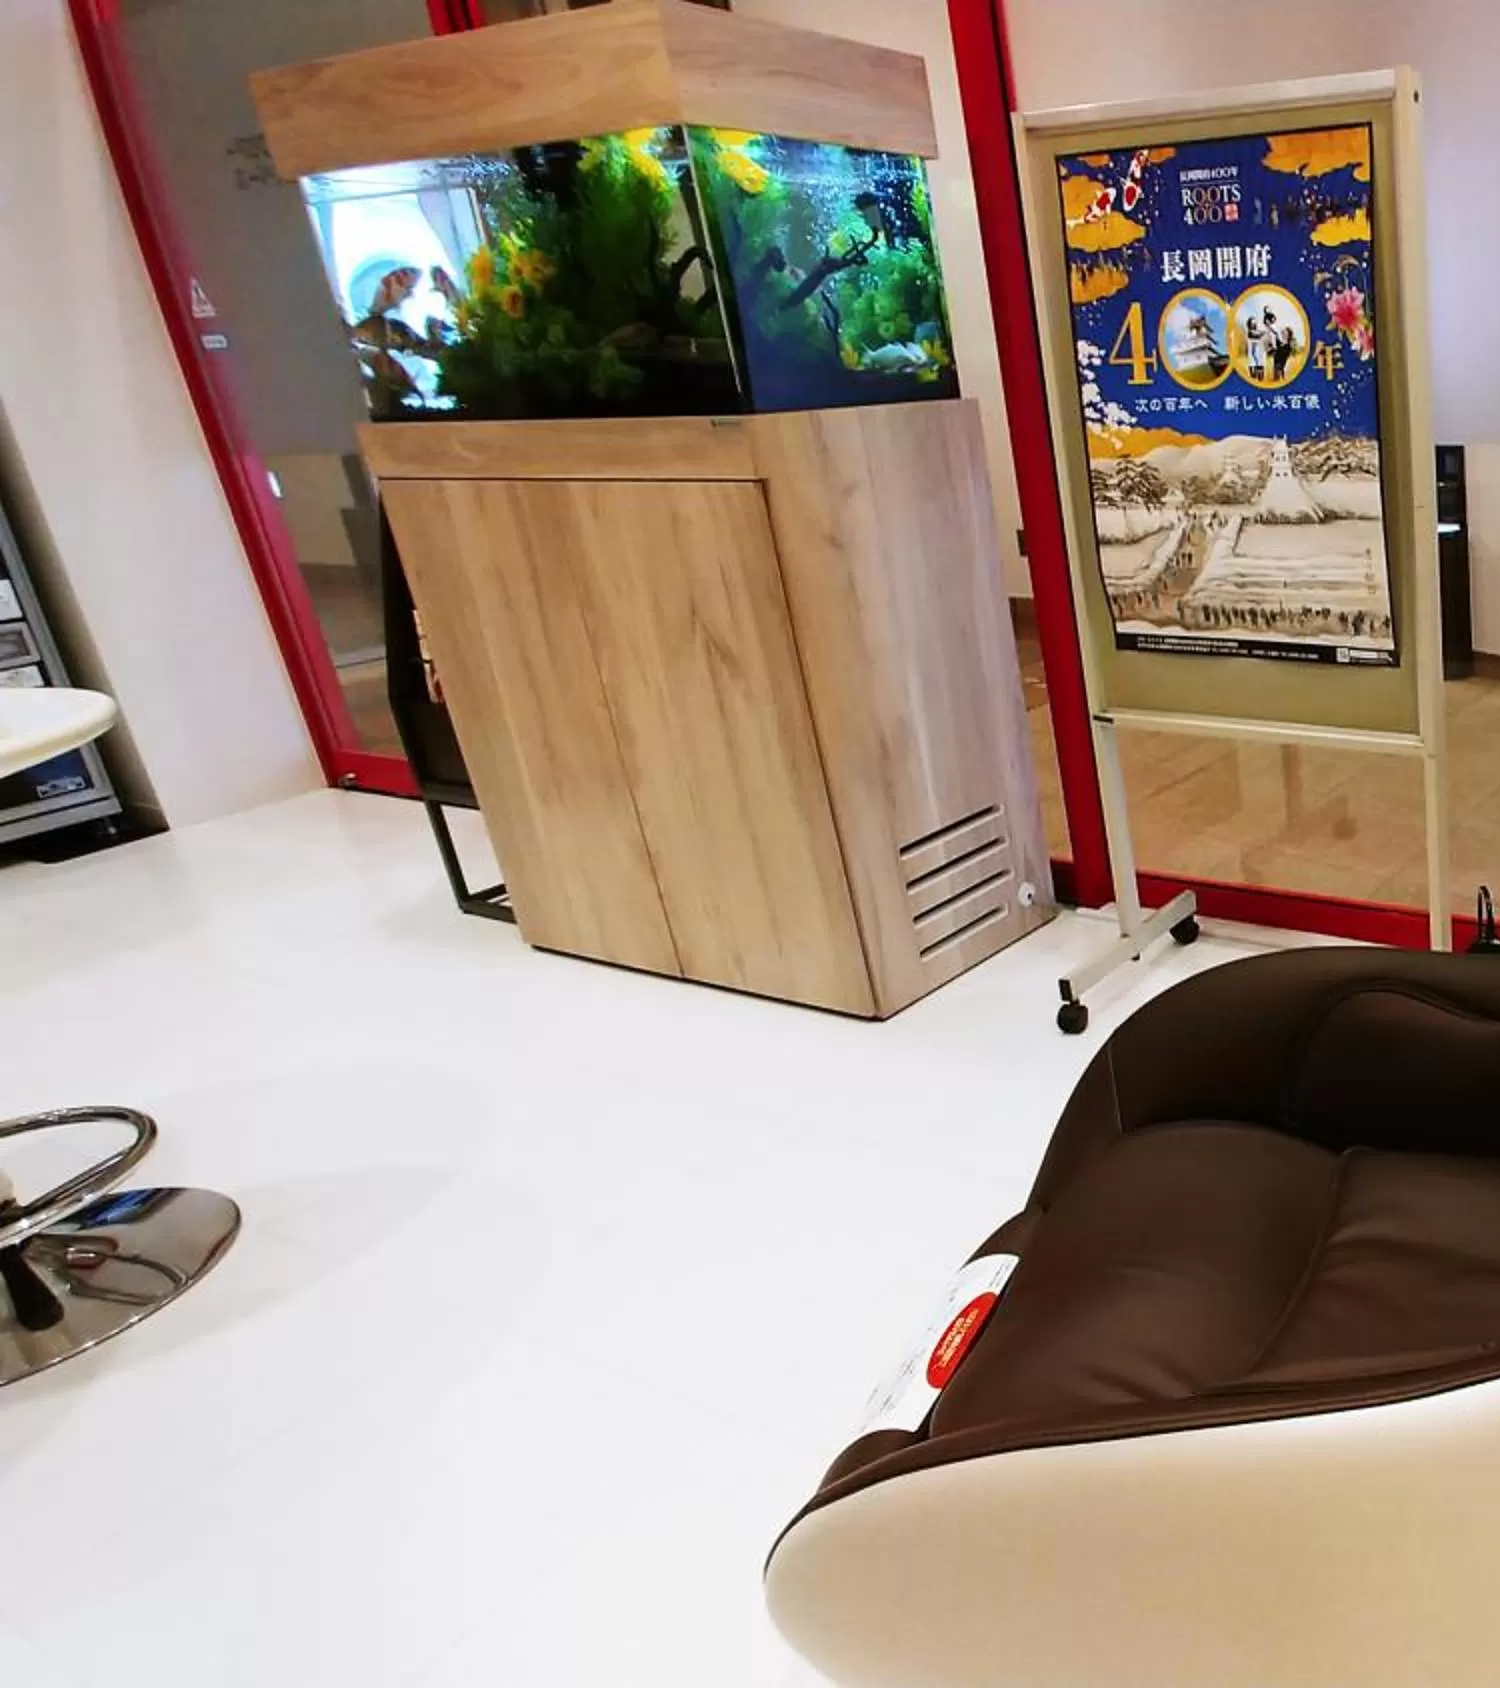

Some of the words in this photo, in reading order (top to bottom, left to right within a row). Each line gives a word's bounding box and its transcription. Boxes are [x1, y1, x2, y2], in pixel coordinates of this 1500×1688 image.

[1180, 184, 1242, 206] ROOTS
[1184, 205, 1223, 225] 400
[1160, 243, 1272, 282] 長岡開府
[1135, 397, 1209, 412] 次の百年へ
